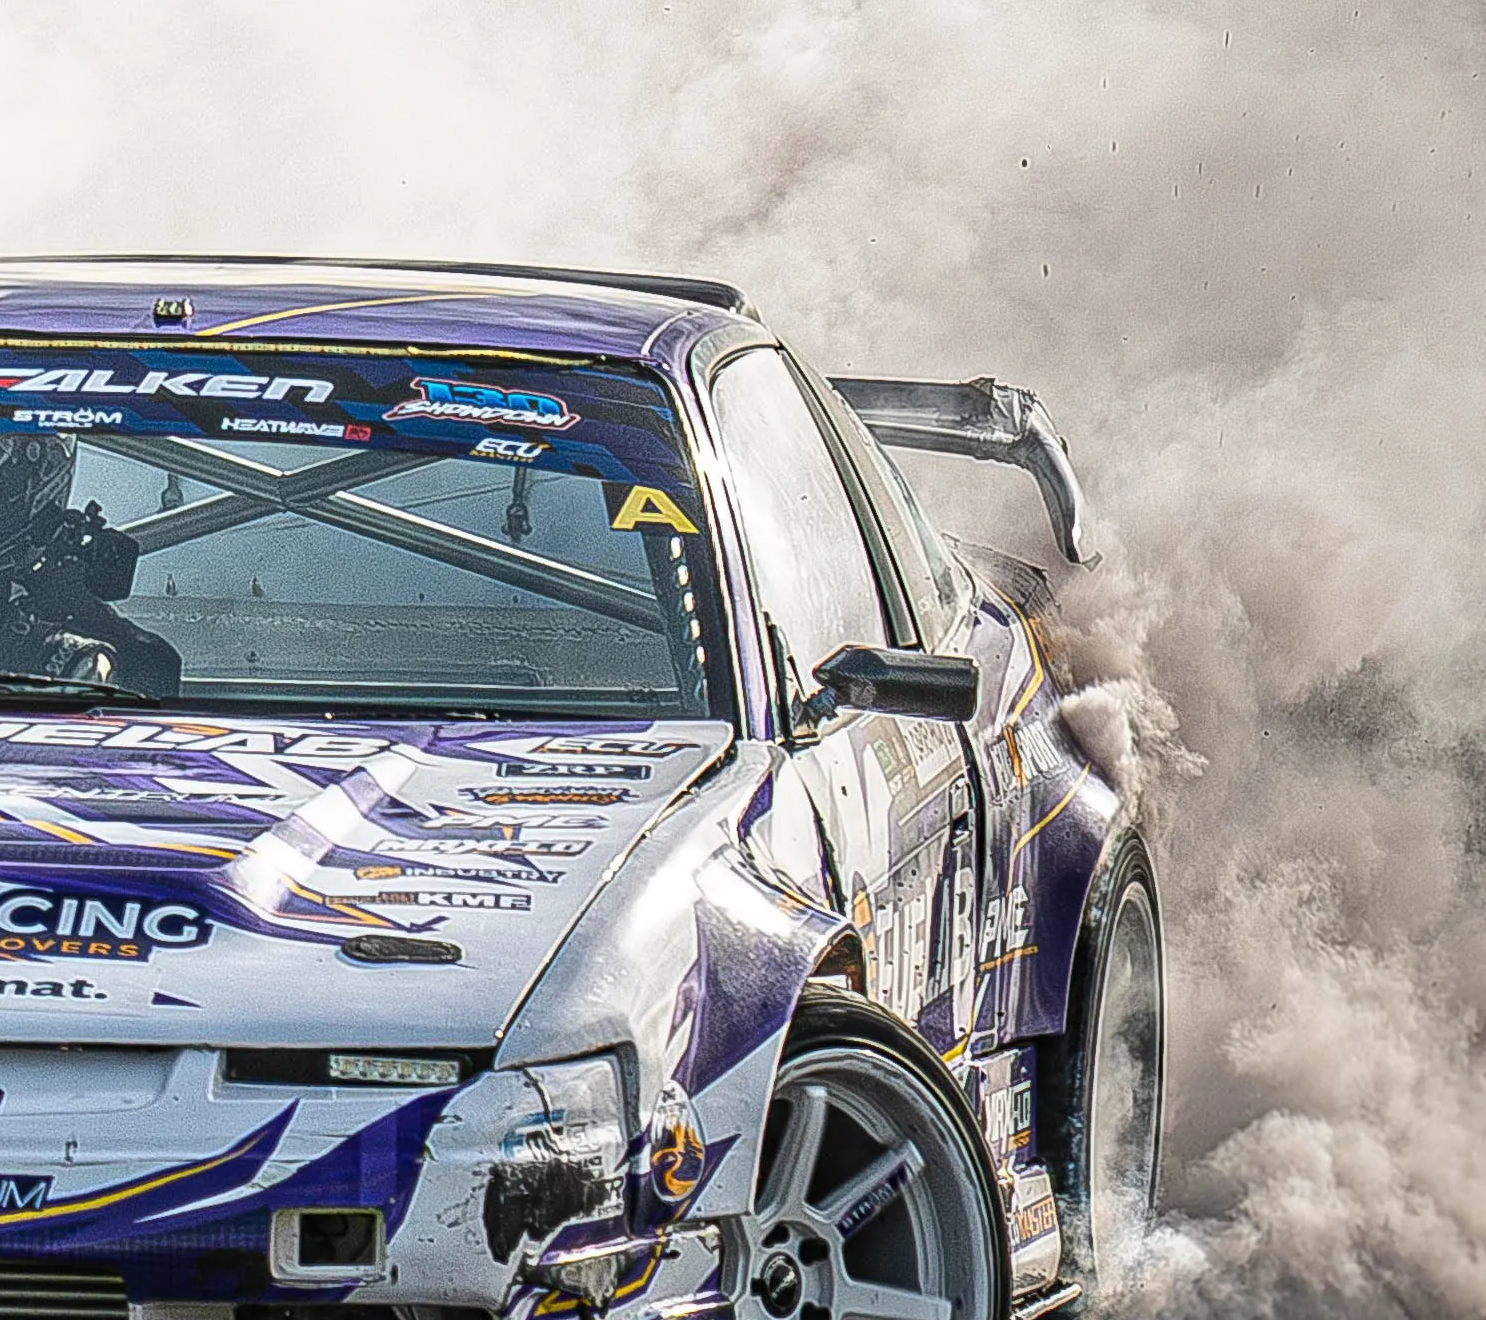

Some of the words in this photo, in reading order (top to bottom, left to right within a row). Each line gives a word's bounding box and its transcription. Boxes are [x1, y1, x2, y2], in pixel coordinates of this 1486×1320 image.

[421, 381, 561, 414] 130
[13, 408, 123, 424] STRÖM
[397, 401, 571, 426] SHOWDOWN
[221, 417, 345, 437] HEATWAVE
[476, 437, 551, 459] ECU
[611, 485, 699, 534] A
[405, 867, 565, 881] INDUSTRY
[419, 893, 531, 909] KME
